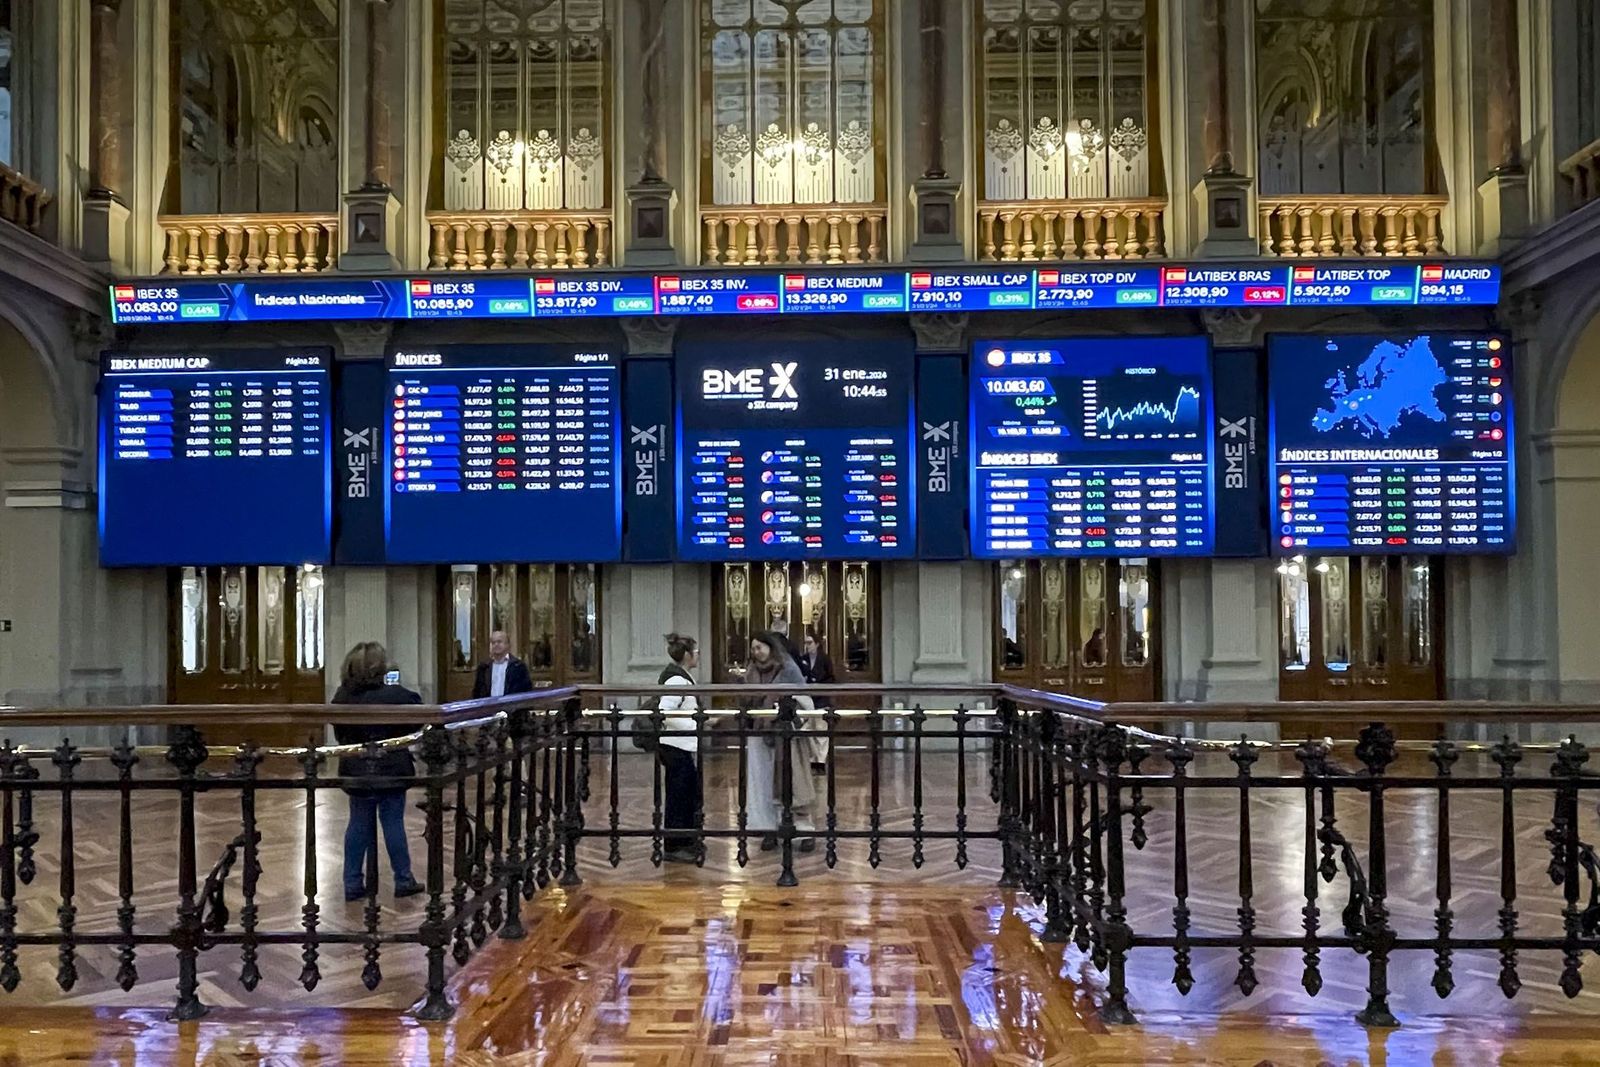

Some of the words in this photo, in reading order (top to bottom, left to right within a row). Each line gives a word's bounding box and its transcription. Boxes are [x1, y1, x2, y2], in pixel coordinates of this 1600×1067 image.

[1061, 274, 1088, 284] IBEX
[1090, 273, 1113, 283] TOP
[1116, 273, 1136, 283] DIV
[1189, 272, 1237, 282] LATIBEX
[1239, 271, 1271, 281] BRAS
[1316, 270, 1365, 280] LATIBEX
[1368, 270, 1390, 280] TOP
[1444, 269, 1490, 280] MADRID
[682, 280, 707, 290] IBEX
[710, 280, 724, 290] 35
[726, 280, 748, 290] INV.
[808, 279, 834, 288] IBEX
[836, 278, 882, 288] MEDIUM
[934, 276, 960, 286] IBEX
[962, 276, 1000, 286] SMALL
[1002, 275, 1027, 285] CAP
[433, 284, 459, 294] IBEX
[461, 284, 475, 294] 35
[557, 282, 584, 292] IBEX
[586, 282, 600, 292] 35
[601, 282, 623, 292] DIV.
[1166, 287, 1228, 298] 12.308,90
[1294, 286, 1350, 296] 5.902,50
[1421, 285, 1463, 296] 994,15
[137, 288, 163, 298] IBEX
[164, 288, 178, 298] 35
[912, 292, 962, 302] 7.910,10
[1039, 289, 1093, 300] 2.773,90
[255, 294, 296, 306] Índices
[300, 294, 365, 305] Nacionales
[413, 299, 474, 310] 10.085,90
[537, 297, 596, 308] 33.817,90
[661, 295, 713, 307] 1.887,40
[786, 294, 847, 304] 13.326,90
[111, 359, 137, 370] IBEX
[138, 358, 186, 369] MEDIUM
[186, 357, 210, 369] CAP
[286, 357, 307, 366] Página
[395, 352, 442, 365] ÍNDICES
[575, 354, 597, 363] Página
[824, 368, 838, 380] 31
[703, 369, 763, 393] BME
[766, 402, 798, 410] company
[1016, 398, 1044, 407] 0,44%
[1281, 448, 1328, 461] ÍNDICES
[1330, 449, 1438, 460] INTERNACIONALES
[928, 447, 946, 492] BME
[1225, 443, 1243, 488] BME
[348, 453, 365, 497] BME
[636, 450, 653, 495] BME
